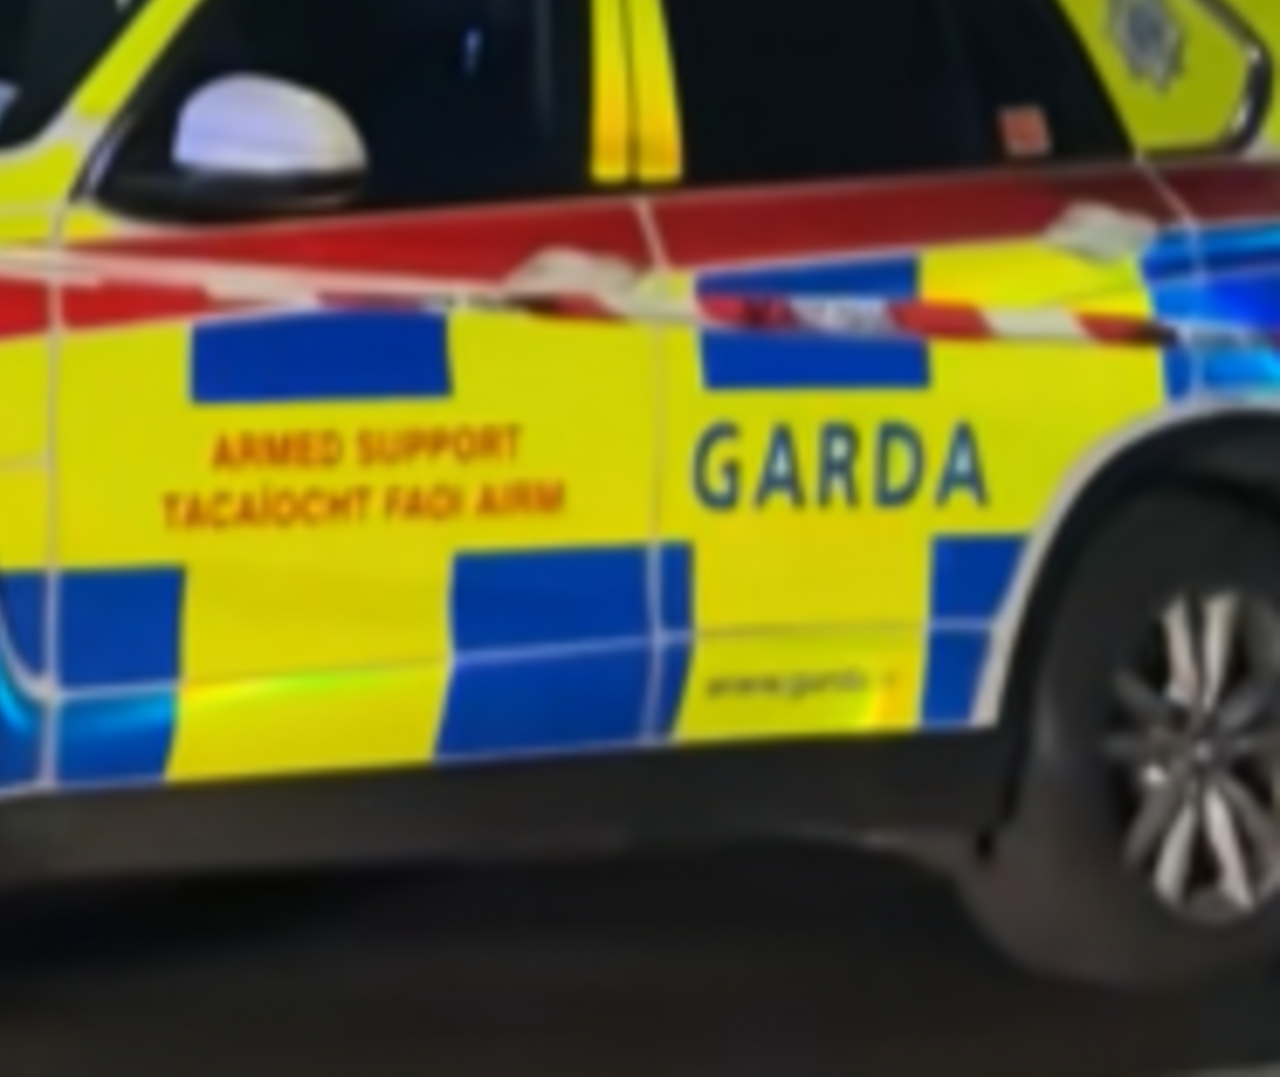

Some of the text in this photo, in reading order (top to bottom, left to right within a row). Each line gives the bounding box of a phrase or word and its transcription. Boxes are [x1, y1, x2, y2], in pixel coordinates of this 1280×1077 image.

[211, 423, 521, 472] ARMED SUPPORT
[691, 419, 989, 513] GARDA
[384, 482, 464, 522] FAOI
[474, 479, 566, 518] AIRM
